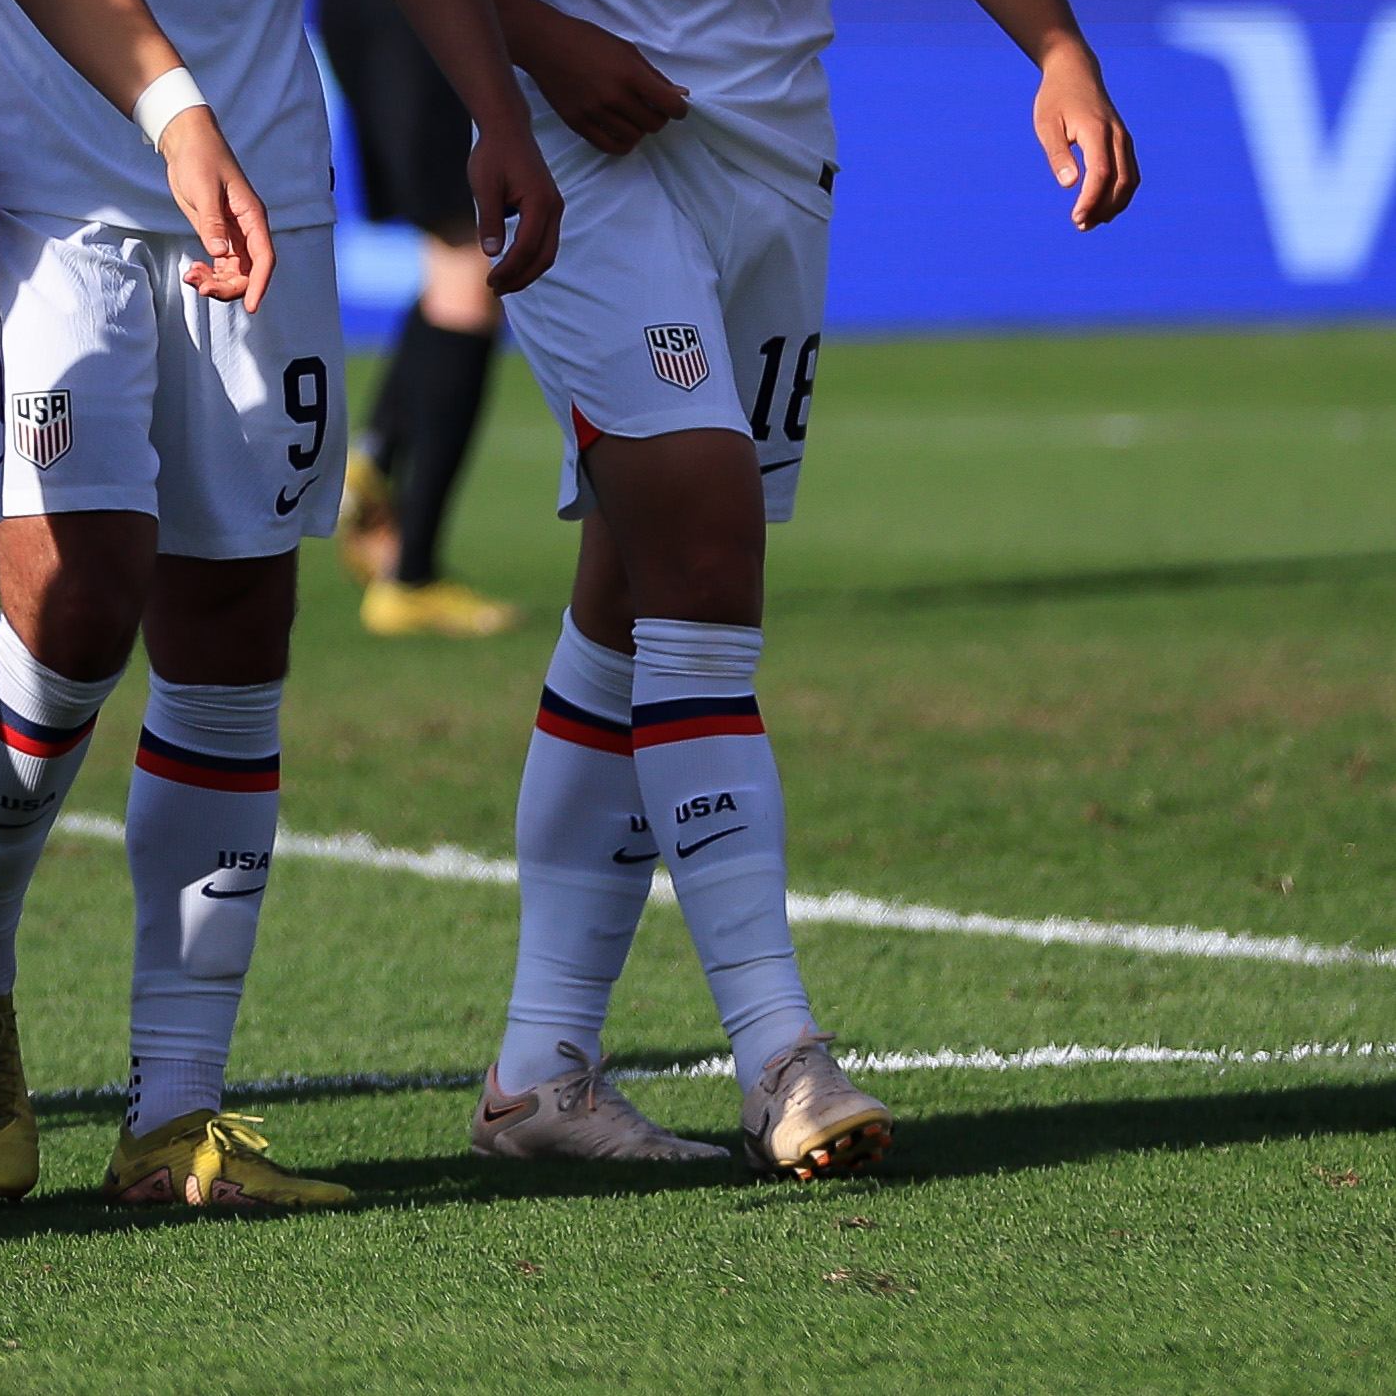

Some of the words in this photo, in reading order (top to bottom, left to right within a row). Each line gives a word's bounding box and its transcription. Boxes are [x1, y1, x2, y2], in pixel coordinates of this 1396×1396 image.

[650, 327, 698, 353] USA
[16, 394, 67, 425] USA
[283, 355, 328, 471] 9
[0, 791, 57, 812] USA
[675, 791, 738, 825] USA
[217, 850, 269, 871] USA
